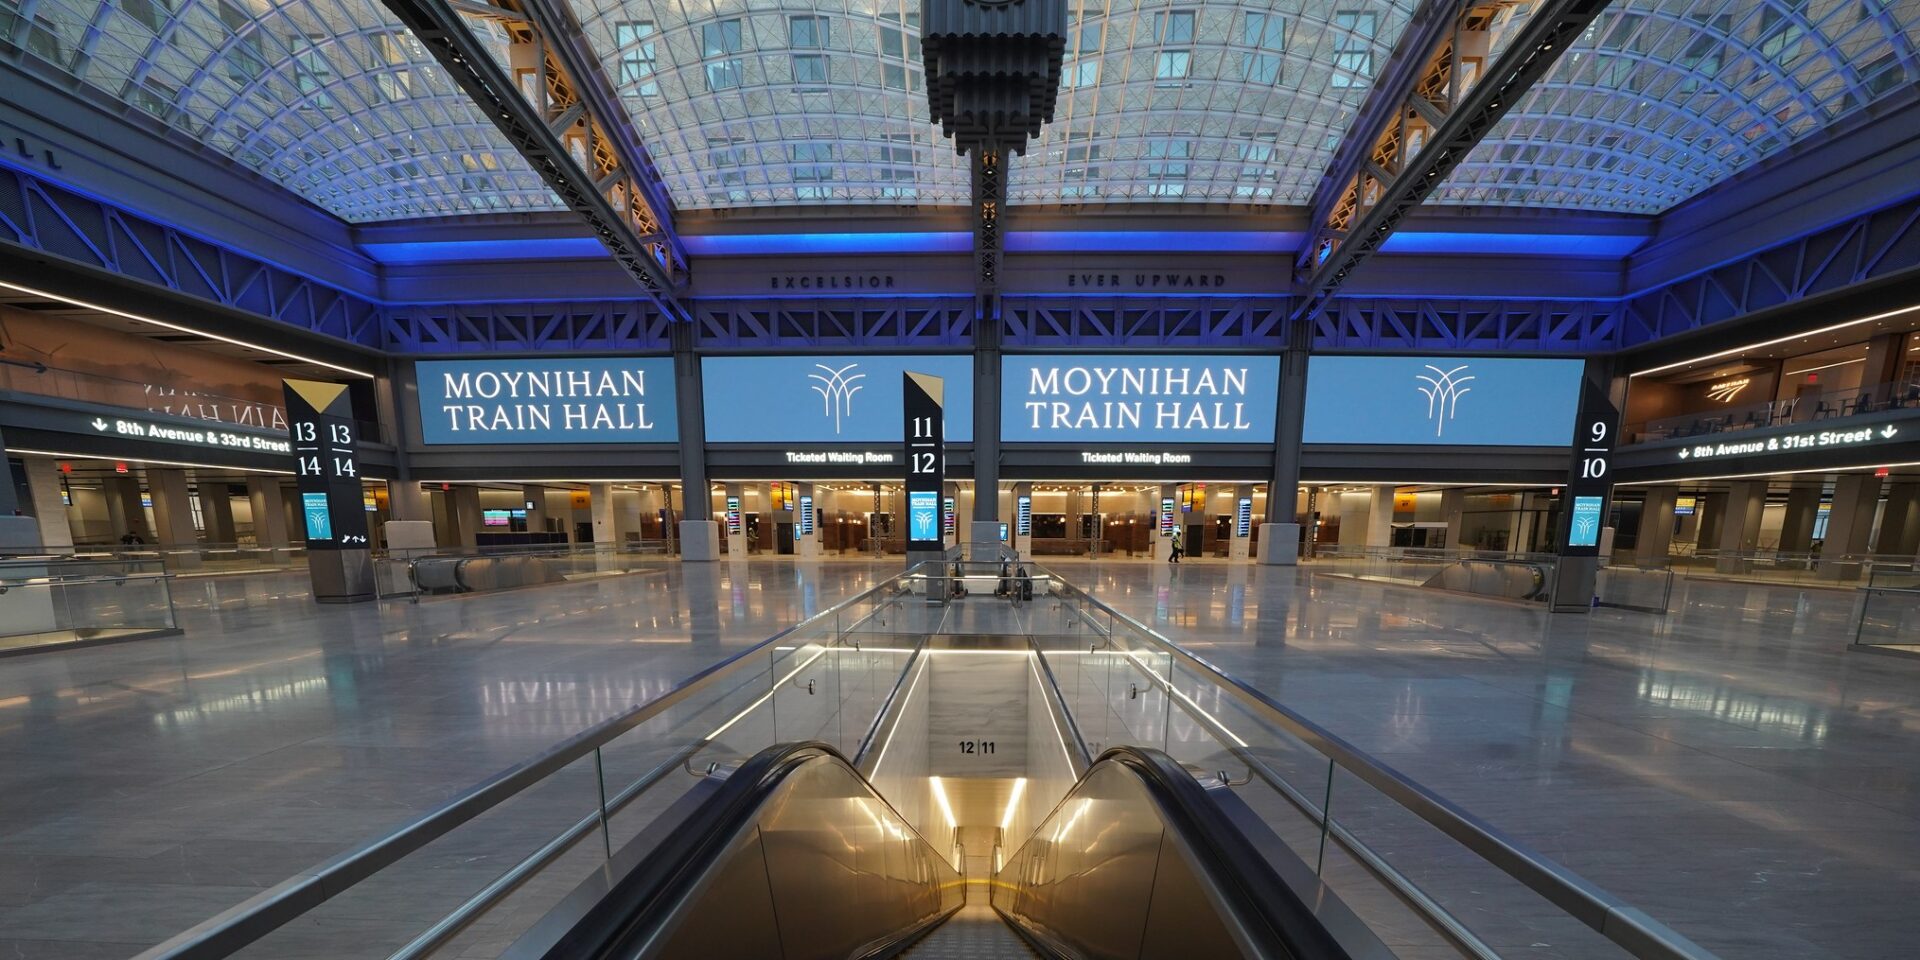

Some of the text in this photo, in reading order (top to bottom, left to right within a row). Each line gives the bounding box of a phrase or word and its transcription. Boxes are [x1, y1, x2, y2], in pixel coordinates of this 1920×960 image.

[0, 137, 62, 170] LL
[770, 276, 894, 289] EXCELSIOR
[1068, 273, 1227, 288] EVER UPWARD
[444, 370, 644, 398] MOYNIHAN
[1029, 367, 1248, 395] MOYNIHAN
[443, 403, 654, 431] TRAIN HALL
[1025, 401, 1251, 429] TRAIN HALL
[116, 420, 291, 454] 8th Avenue & 33rd Street
[295, 422, 316, 442] 13
[330, 424, 351, 444] 13
[913, 417, 932, 438] 11
[1591, 417, 1607, 442] 9
[1693, 427, 1873, 458] 8th Avenue & 31st Street
[299, 456, 322, 476] 14
[334, 457, 356, 477] 14
[786, 452, 893, 465] Ticketed Waiting Room
[912, 453, 936, 474] 12
[1081, 452, 1191, 465] Ticketed Waiting Room
[1583, 450, 1606, 476] 10
[958, 740, 996, 754] 12 11
